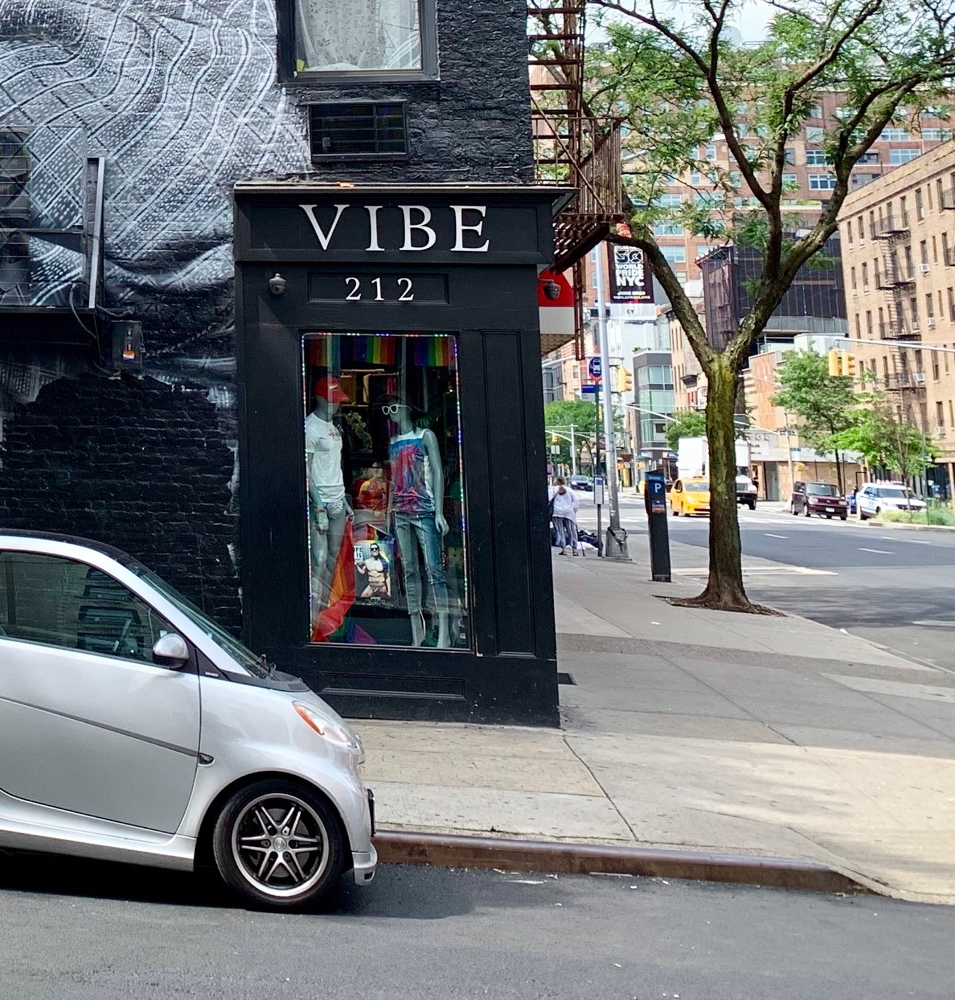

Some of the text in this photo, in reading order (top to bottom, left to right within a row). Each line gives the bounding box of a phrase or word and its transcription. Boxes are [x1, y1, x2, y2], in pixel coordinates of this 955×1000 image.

[298, 204, 490, 252] VIBE
[616, 269, 645, 277] PRIDE
[616, 276, 645, 287] NYC
[345, 277, 415, 301] 212
[654, 483, 662, 493] P
